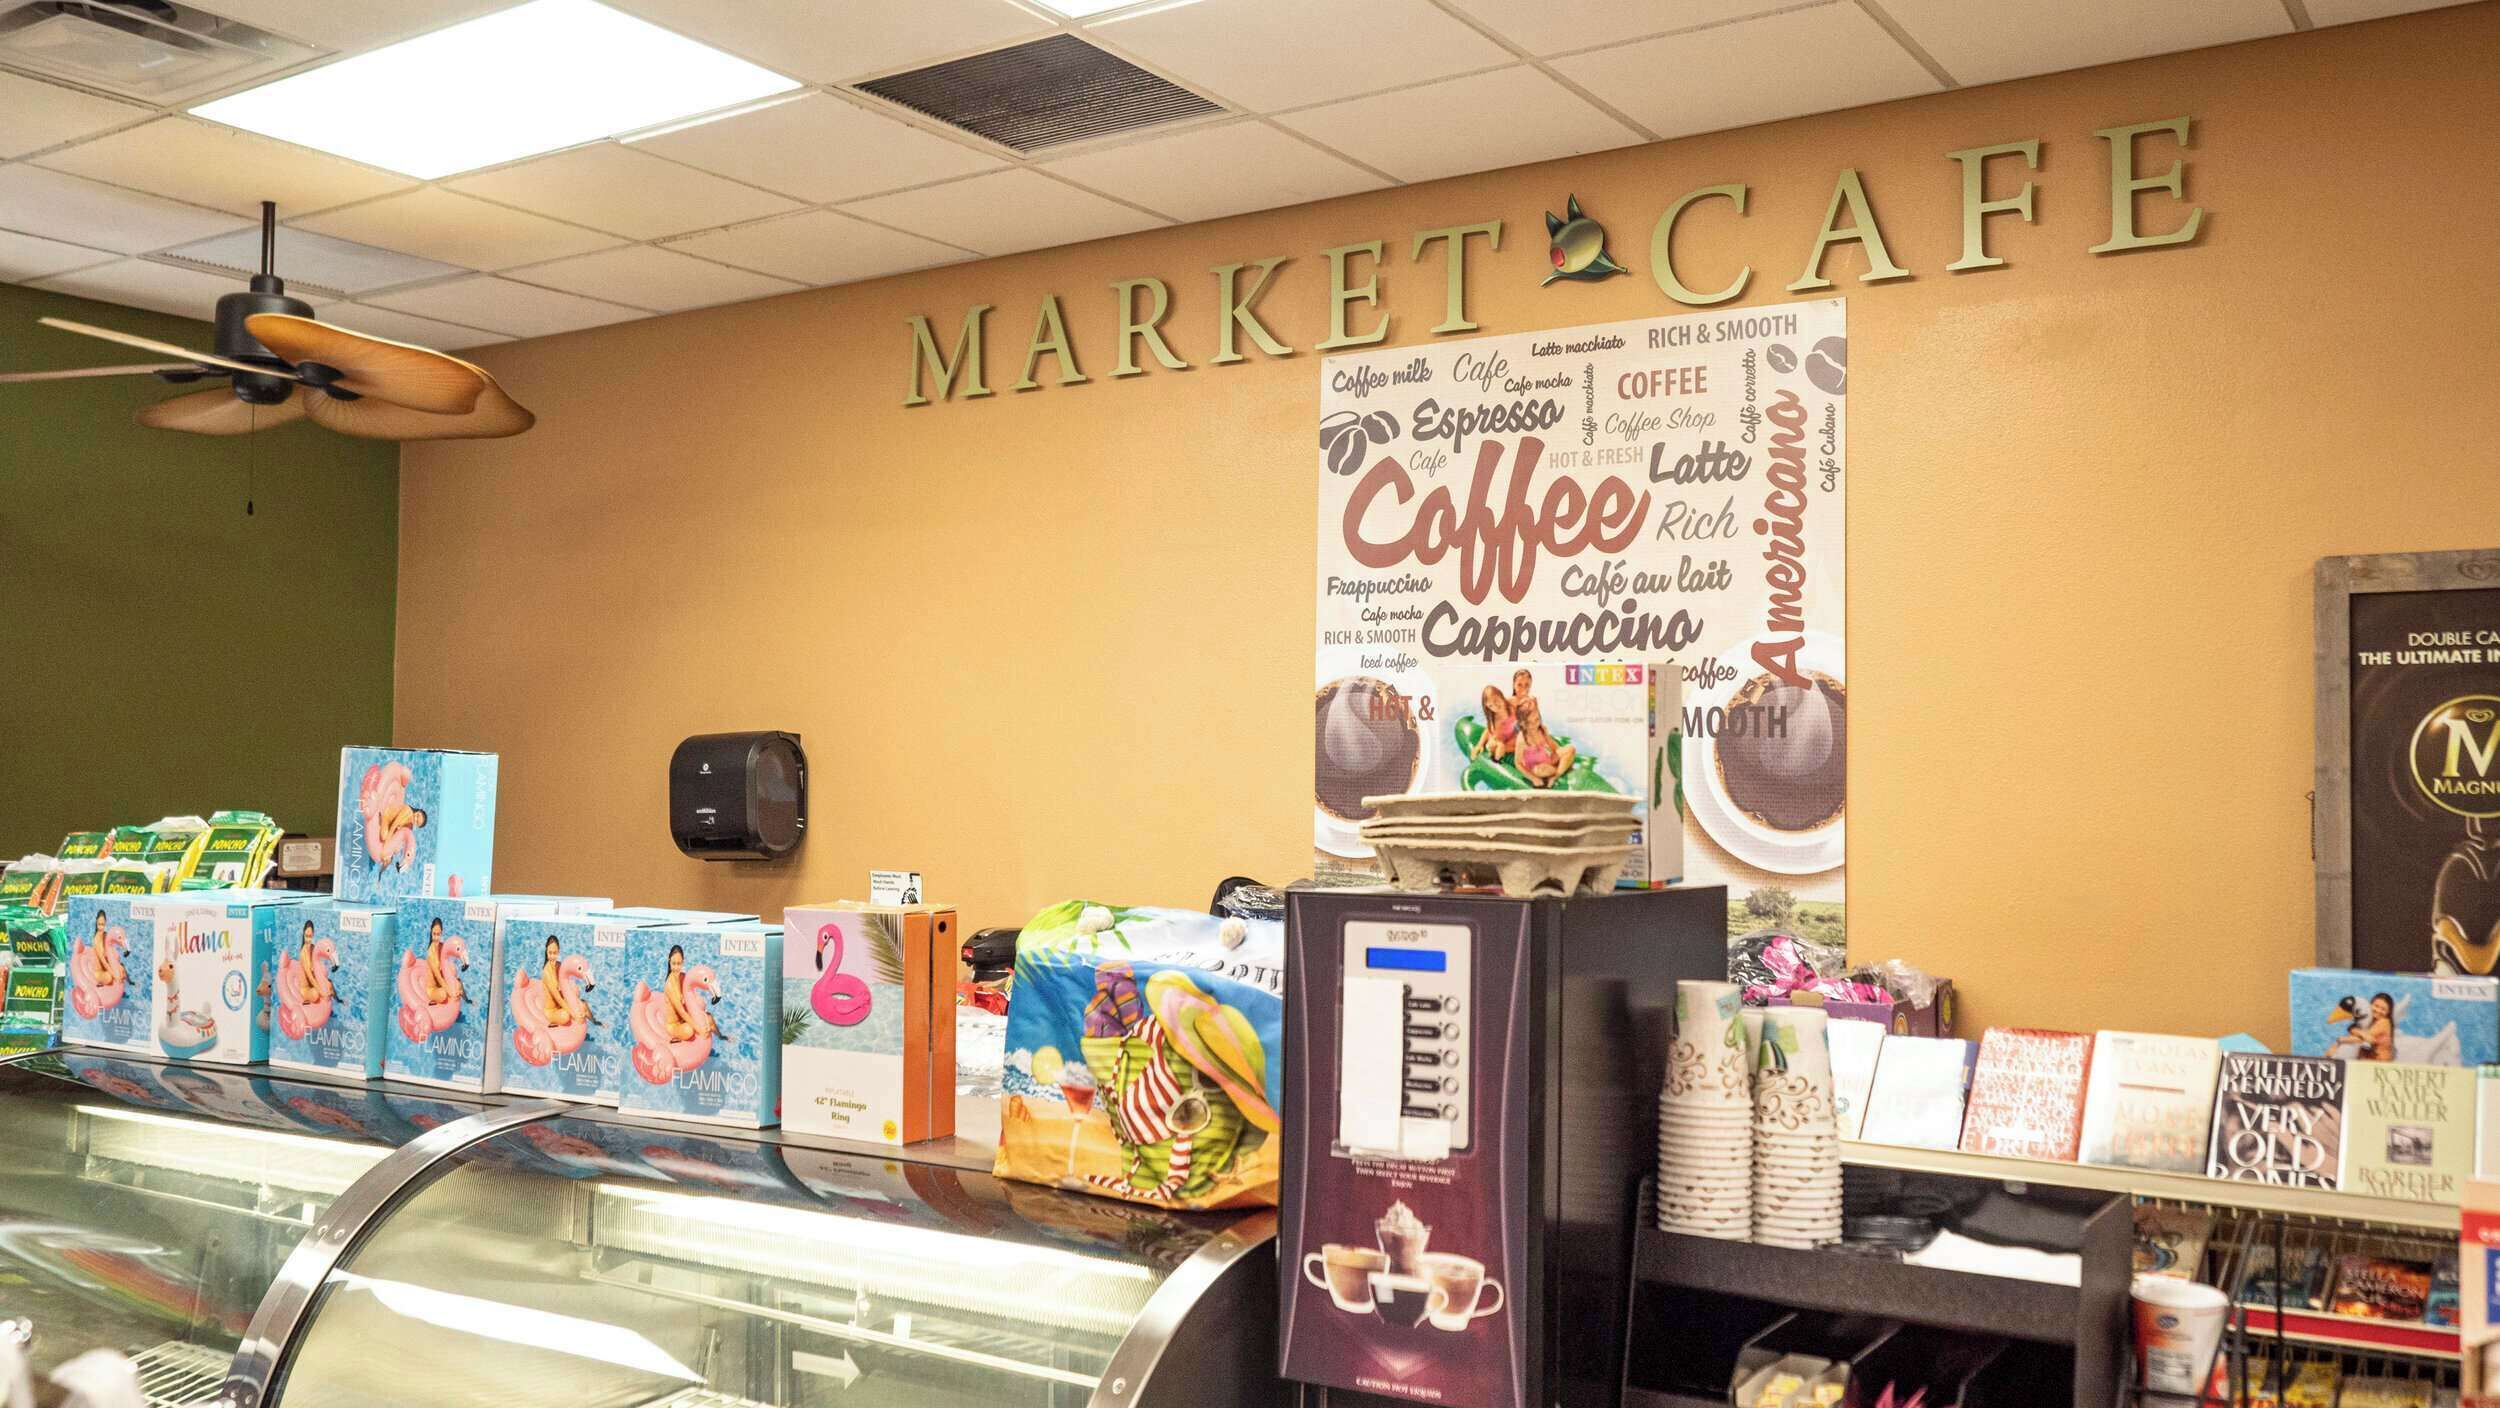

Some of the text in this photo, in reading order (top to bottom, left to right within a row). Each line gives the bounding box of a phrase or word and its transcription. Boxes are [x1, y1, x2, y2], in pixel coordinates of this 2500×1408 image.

[904, 115, 2204, 408] MARKET CAFE
[1648, 314, 1798, 349] RICH & SMOOTH
[1532, 334, 1627, 357] Latte macchiato
[1332, 357, 1433, 399] Coffee milk
[1453, 350, 1511, 393] Cafe
[1504, 371, 1574, 397] Cafe mocha
[1617, 365, 1708, 401] COFFEE
[1740, 348, 1758, 402] corretto
[1583, 362, 1595, 414] macchiato
[1411, 397, 1567, 454] Espresso
[1604, 405, 1717, 442] Coffee Shop
[1820, 402, 1837, 456] Cubano
[1409, 448, 1449, 478] Cafe
[1549, 446, 1644, 469] HOT & FRESH
[1650, 440, 1753, 486] Latte
[1342, 435, 1652, 606] Coffee
[1656, 495, 1739, 542] Rich
[1750, 388, 1813, 690] Americano
[1327, 572, 1433, 604] Frappuccino
[1560, 554, 1733, 609] Café au lait
[1361, 604, 1425, 627] Cafe mocha
[1324, 627, 1416, 646] RICH & SMOOTH
[1421, 597, 1704, 664] Cappuccino
[2408, 631, 2472, 647] DOUBLE
[1360, 654, 1419, 673] Iced coffee
[2359, 651, 2392, 666] THE
[2396, 649, 2482, 665] ULTIMATE
[1567, 666, 1642, 684] INTEX
[1681, 657, 1738, 690] coffee
[1369, 695, 1435, 721] HOT &
[1681, 705, 1787, 738] MOOTH
[211, 839, 248, 850] PONCHO
[349, 799, 366, 900] FLAMINGO
[109, 883, 145, 895] PONCHO
[342, 915, 368, 929] INTEX
[466, 904, 491, 918] INTEX
[16, 941, 50, 953] PONCHO
[178, 920, 231, 955] llama
[597, 930, 625, 944] INTE
[724, 938, 760, 953] INTEX
[15, 985, 49, 998] PONCHO
[2437, 984, 2488, 997] INTEX
[303, 1025, 366, 1051] FLAMINGO
[418, 1033, 483, 1059] FLAMINGO
[550, 1051, 621, 1077] FLAMING
[2228, 1057, 2337, 1084] WILLIAM
[2374, 1066, 2448, 1089] ROBERT
[670, 1067, 759, 1097] FLAMINGO
[2223, 1074, 2343, 1101] KENNEDY
[830, 1097, 867, 1112] Flamingo
[831, 1111, 851, 1124] Ring
[2366, 1098, 2449, 1123] WALLER
[2236, 1102, 2325, 1136] VERY
[2228, 1129, 2327, 1173] OLD
[2358, 1166, 2455, 1193] BORDER
